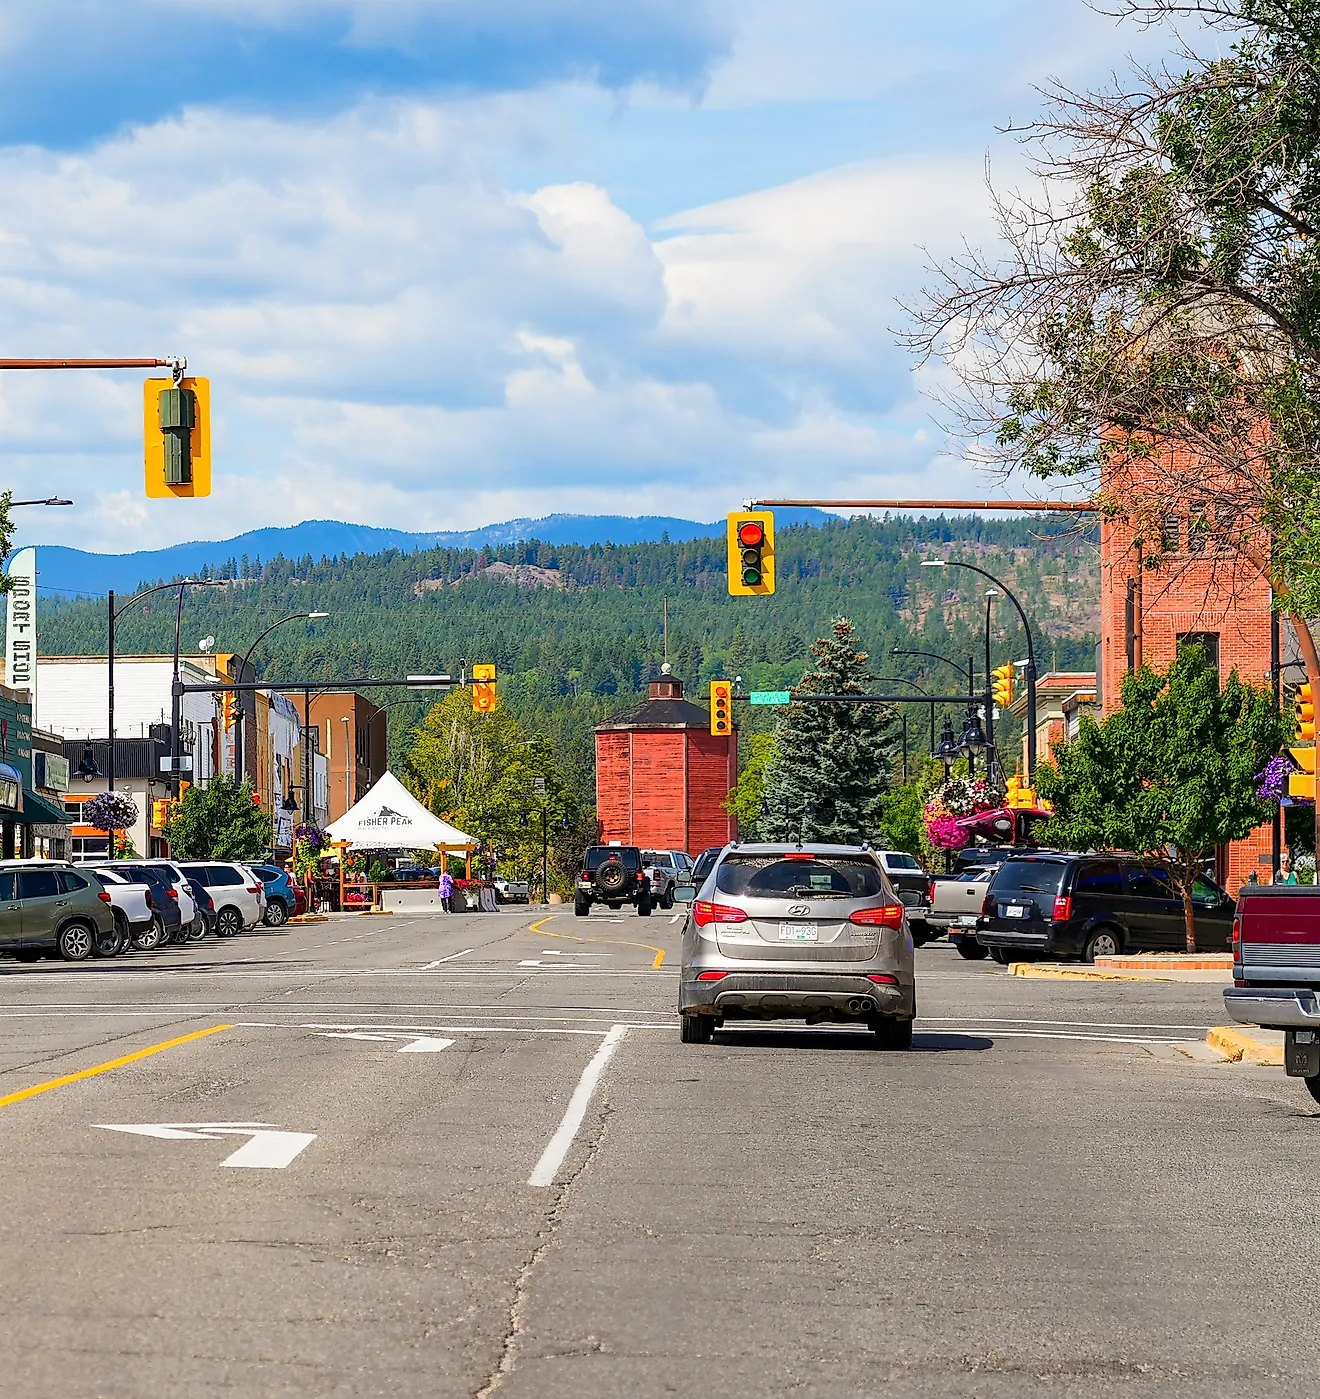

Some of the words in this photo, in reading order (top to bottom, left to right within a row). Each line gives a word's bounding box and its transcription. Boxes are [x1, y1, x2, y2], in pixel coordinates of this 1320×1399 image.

[12, 576, 31, 633] SPORT
[358, 816, 388, 827] FISHER
[390, 816, 413, 826] PEAK
